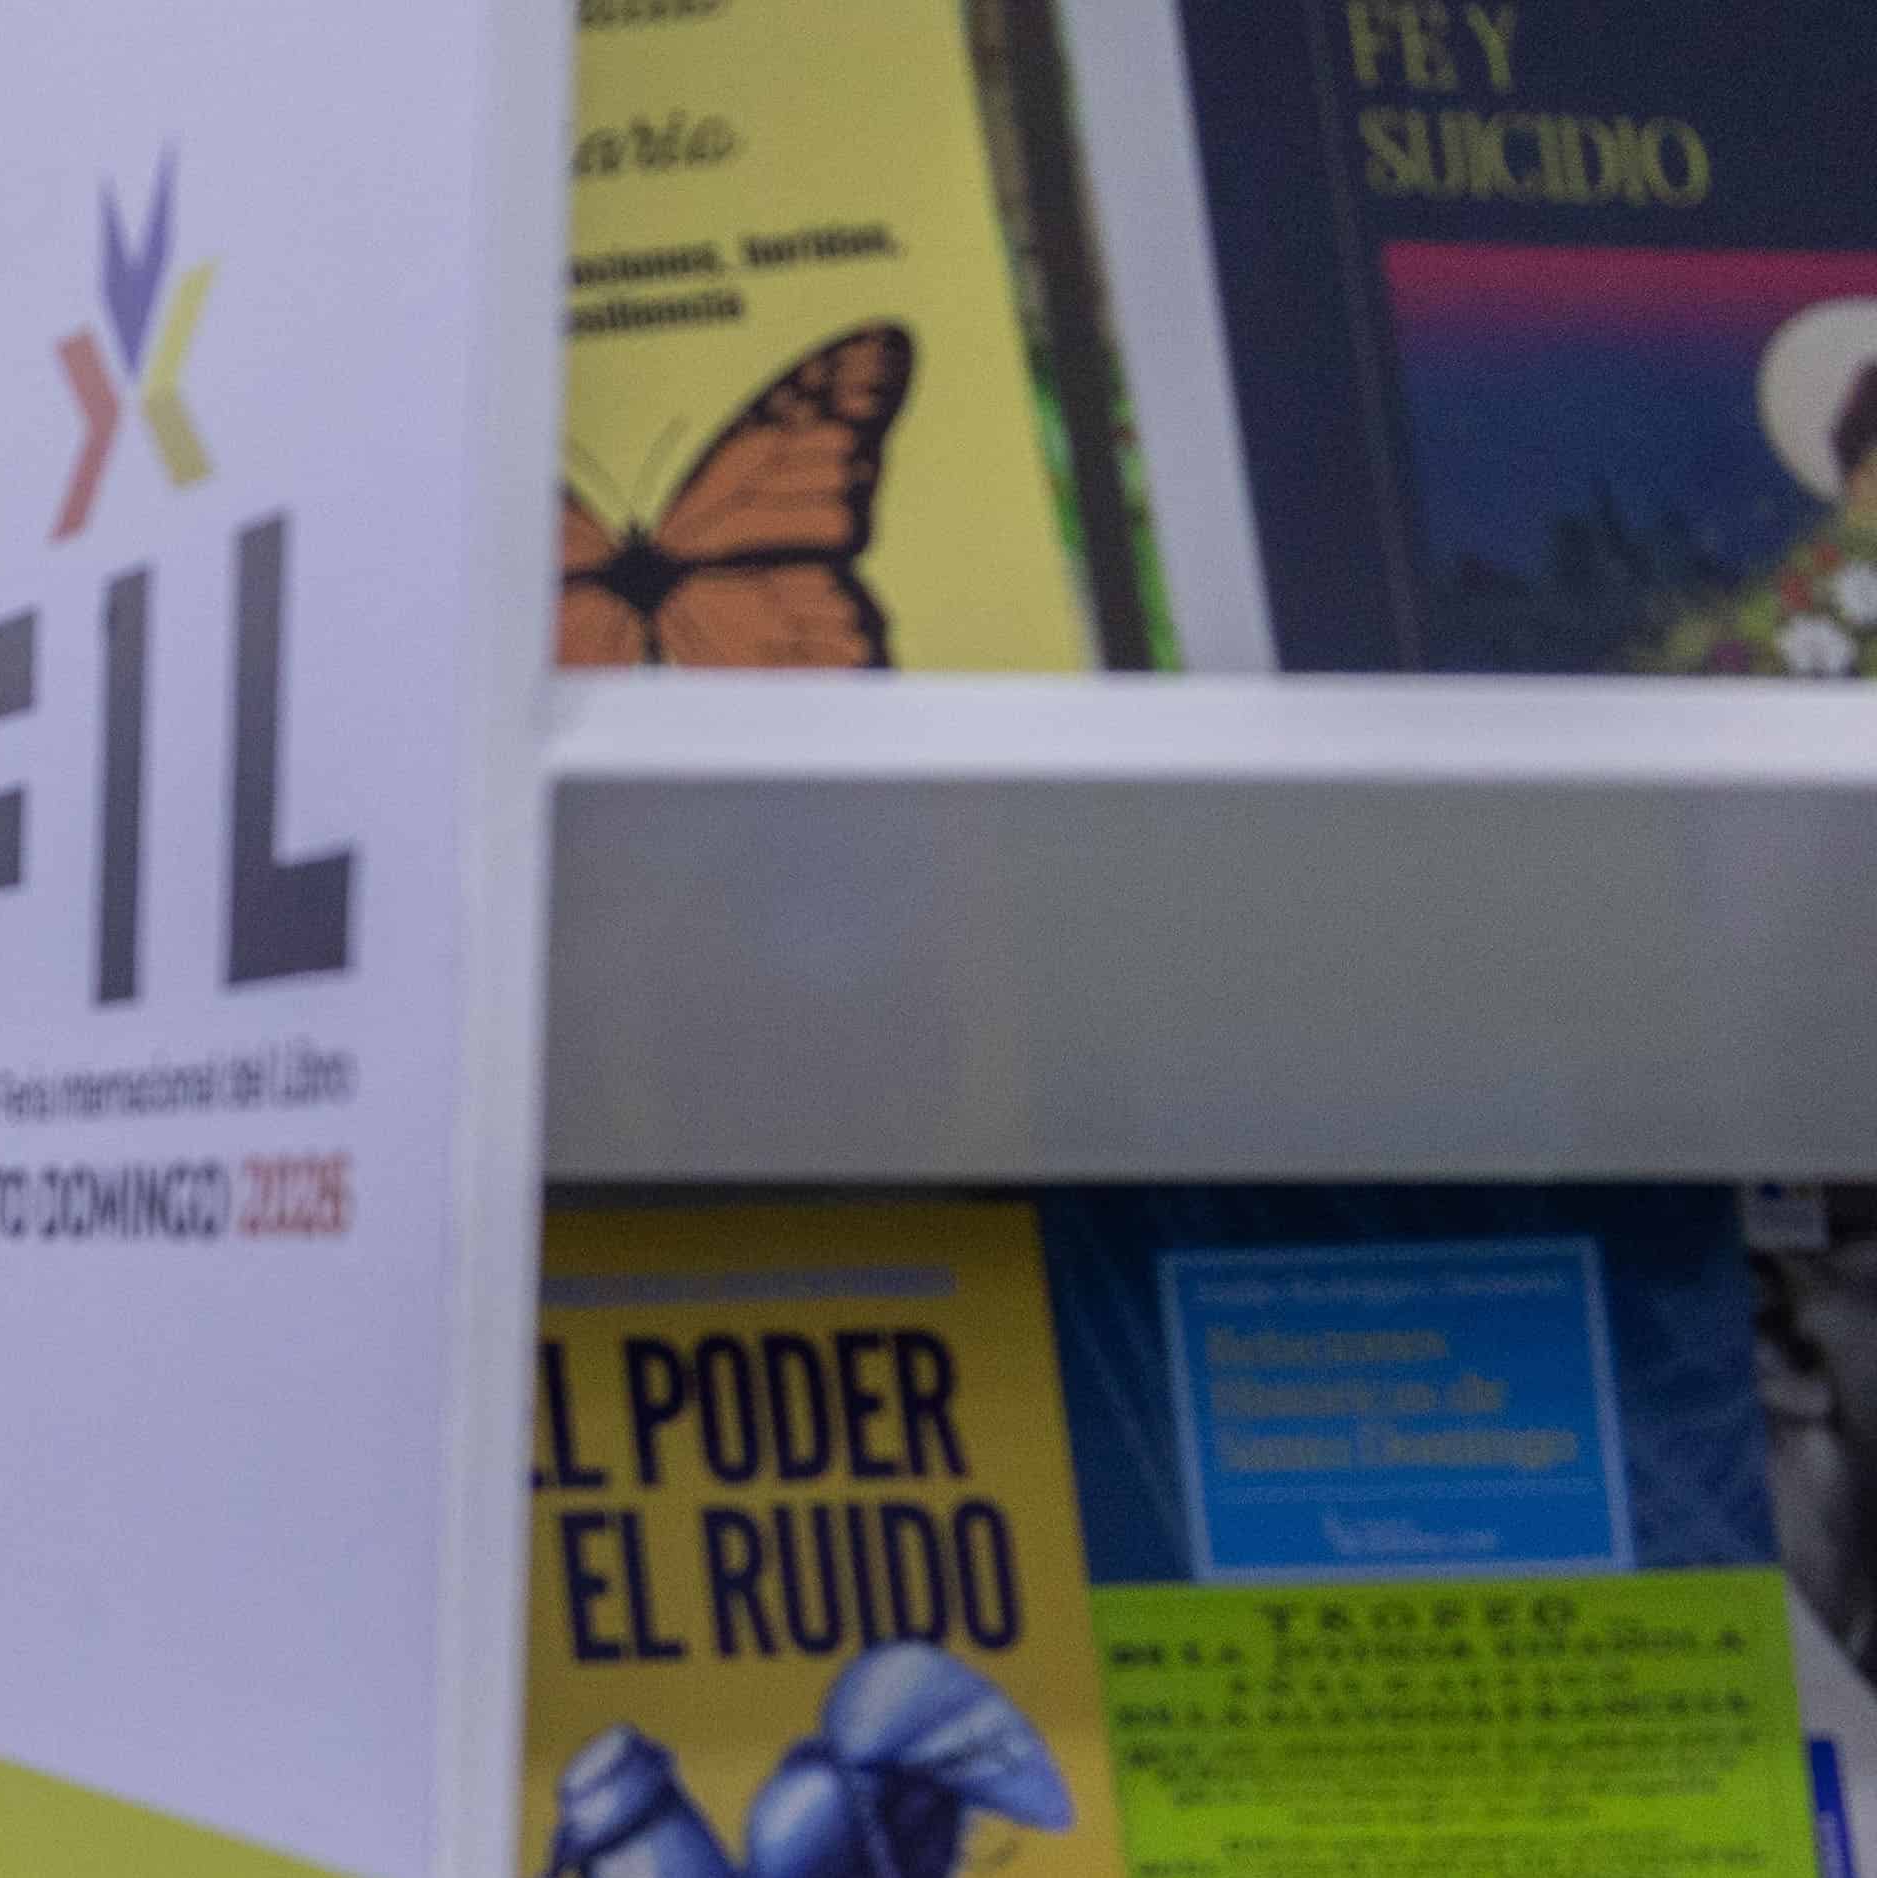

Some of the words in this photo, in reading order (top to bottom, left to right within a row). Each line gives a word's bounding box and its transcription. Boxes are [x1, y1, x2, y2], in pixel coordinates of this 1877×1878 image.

[1364, 108, 1710, 205] SUICIDIO
[39, 1158, 233, 1242] DOMINGO
[623, 1325, 972, 1488] PODER
[559, 1507, 687, 1667] EL
[700, 1496, 1028, 1665] RUIDO
